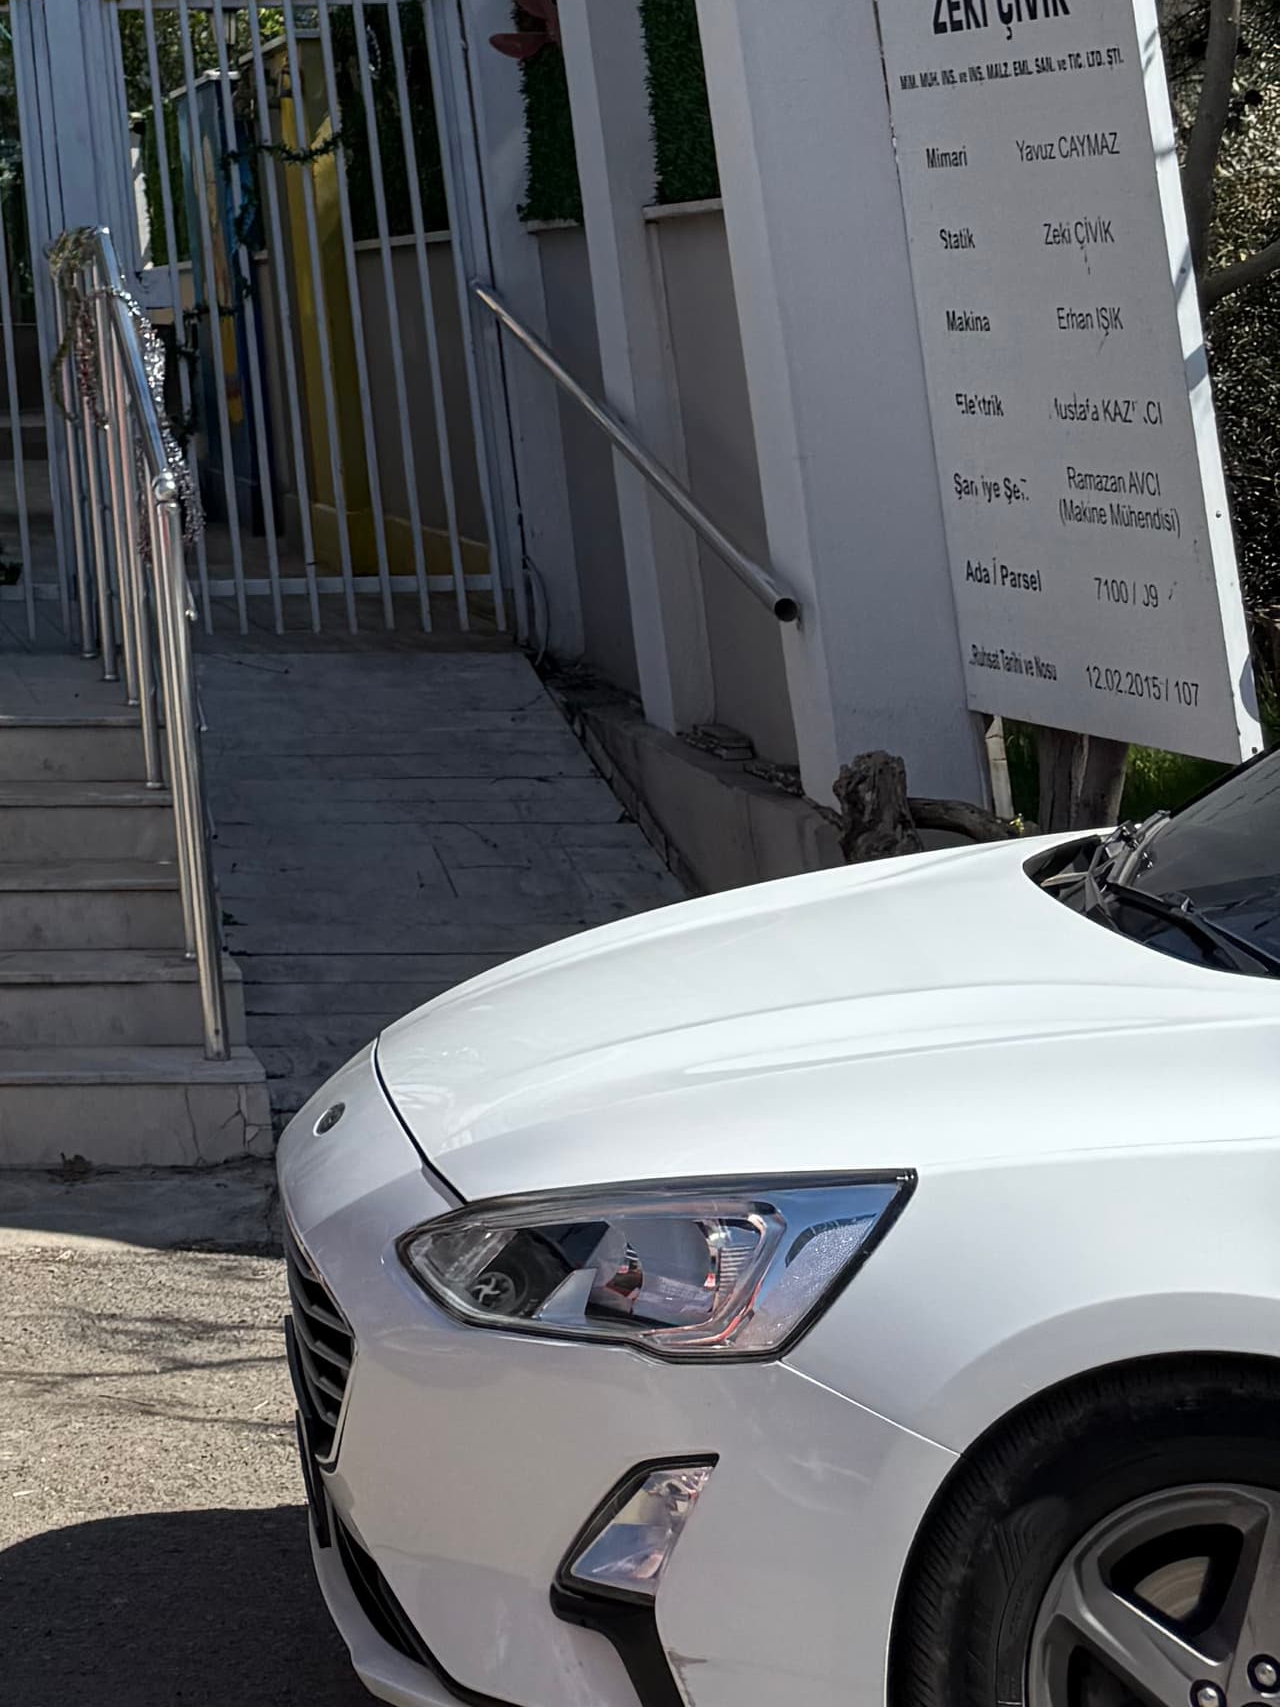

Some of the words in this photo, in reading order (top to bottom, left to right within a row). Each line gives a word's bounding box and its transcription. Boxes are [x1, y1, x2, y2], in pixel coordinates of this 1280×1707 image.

[926, 145, 968, 169] Mimari
[1016, 139, 1056, 163] Yavuz
[1058, 132, 1120, 160] CAYMAZ
[940, 228, 975, 250] Statik
[1043, 221, 1071, 246] Zeki
[1074, 216, 1115, 254] ÇİVİK
[946, 309, 991, 332] Makina
[1057, 307, 1093, 330] Erhan
[1096, 307, 1124, 336] IŞIK
[1102, 398, 1163, 425] KAZCI
[953, 472, 1000, 503] Şaniye
[1067, 466, 1126, 493] Ramazan
[1129, 470, 1161, 496] AVCI
[1060, 498, 1107, 526] (Makine
[966, 560, 990, 585] Ada
[1000, 563, 1042, 593] Parsel
[1094, 577, 1129, 605] 7100
[1086, 665, 1162, 701] 12.02.2015
[1174, 680, 1200, 708] 107
